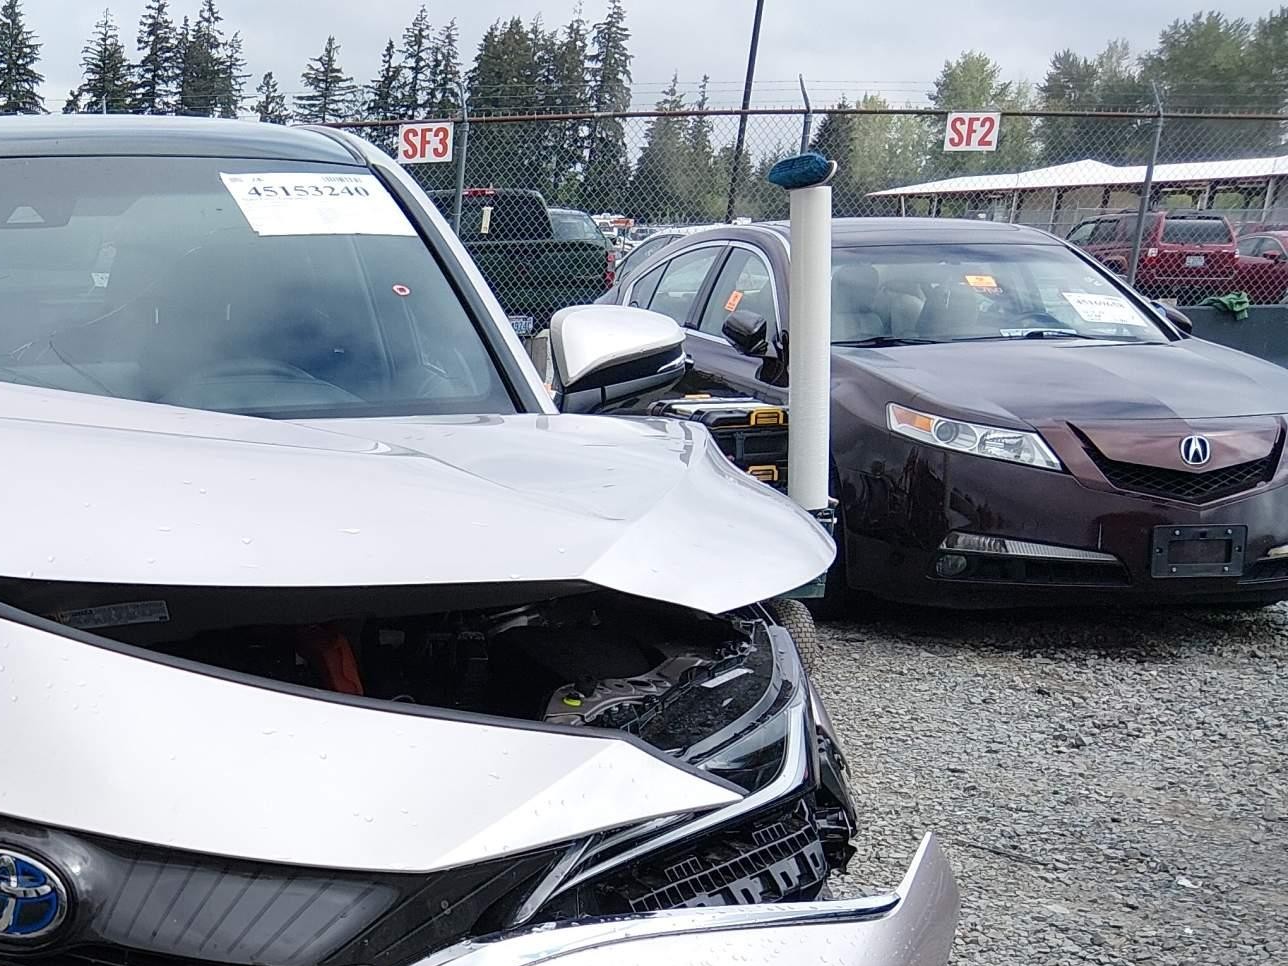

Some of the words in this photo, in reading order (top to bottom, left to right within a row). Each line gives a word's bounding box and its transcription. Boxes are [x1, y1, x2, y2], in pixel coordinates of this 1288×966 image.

[403, 127, 449, 158] SF3
[950, 117, 995, 147] SF2
[248, 185, 370, 197] 45153240
